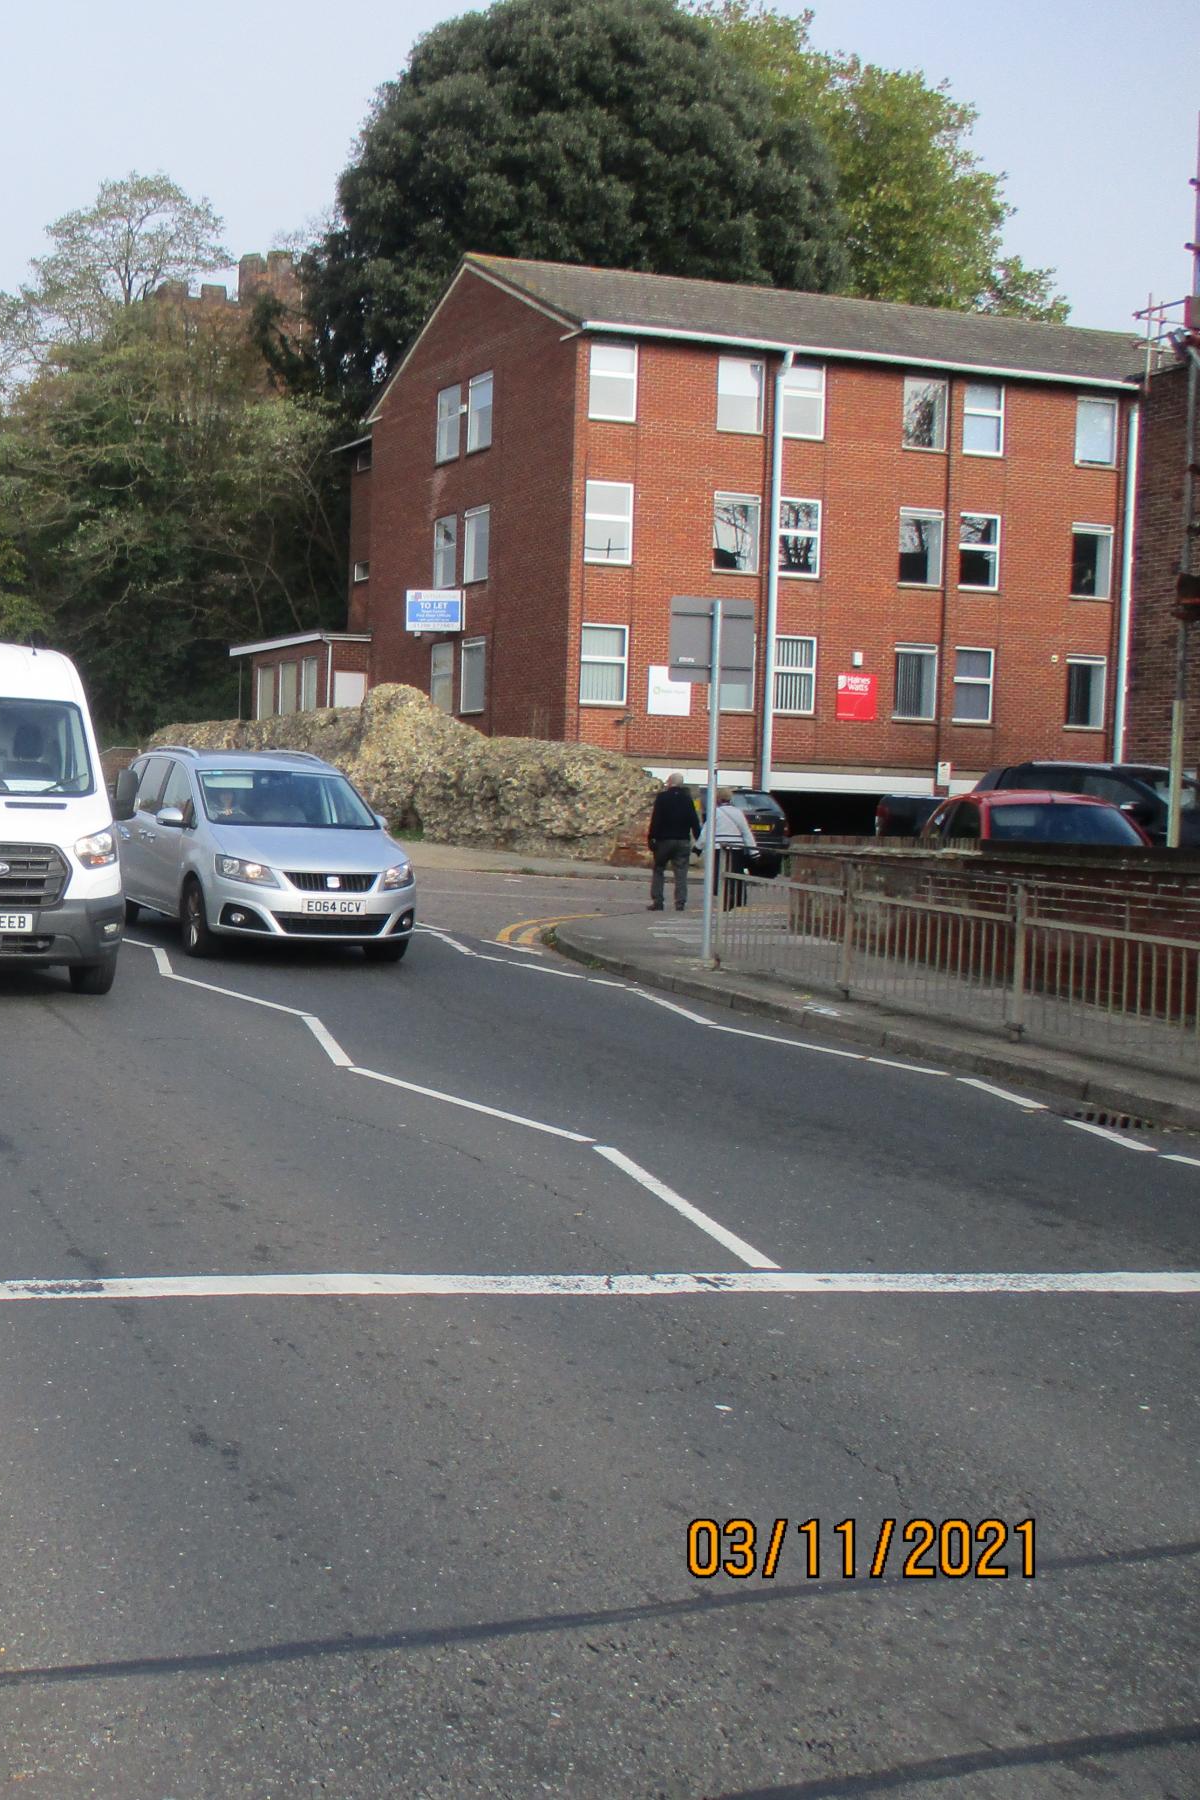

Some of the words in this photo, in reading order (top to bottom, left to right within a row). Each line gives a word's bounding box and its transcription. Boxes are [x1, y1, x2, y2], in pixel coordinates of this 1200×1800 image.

[847, 675, 871, 684] Haines
[847, 683, 869, 691] Watts
[340, 902, 361, 912] GCV
